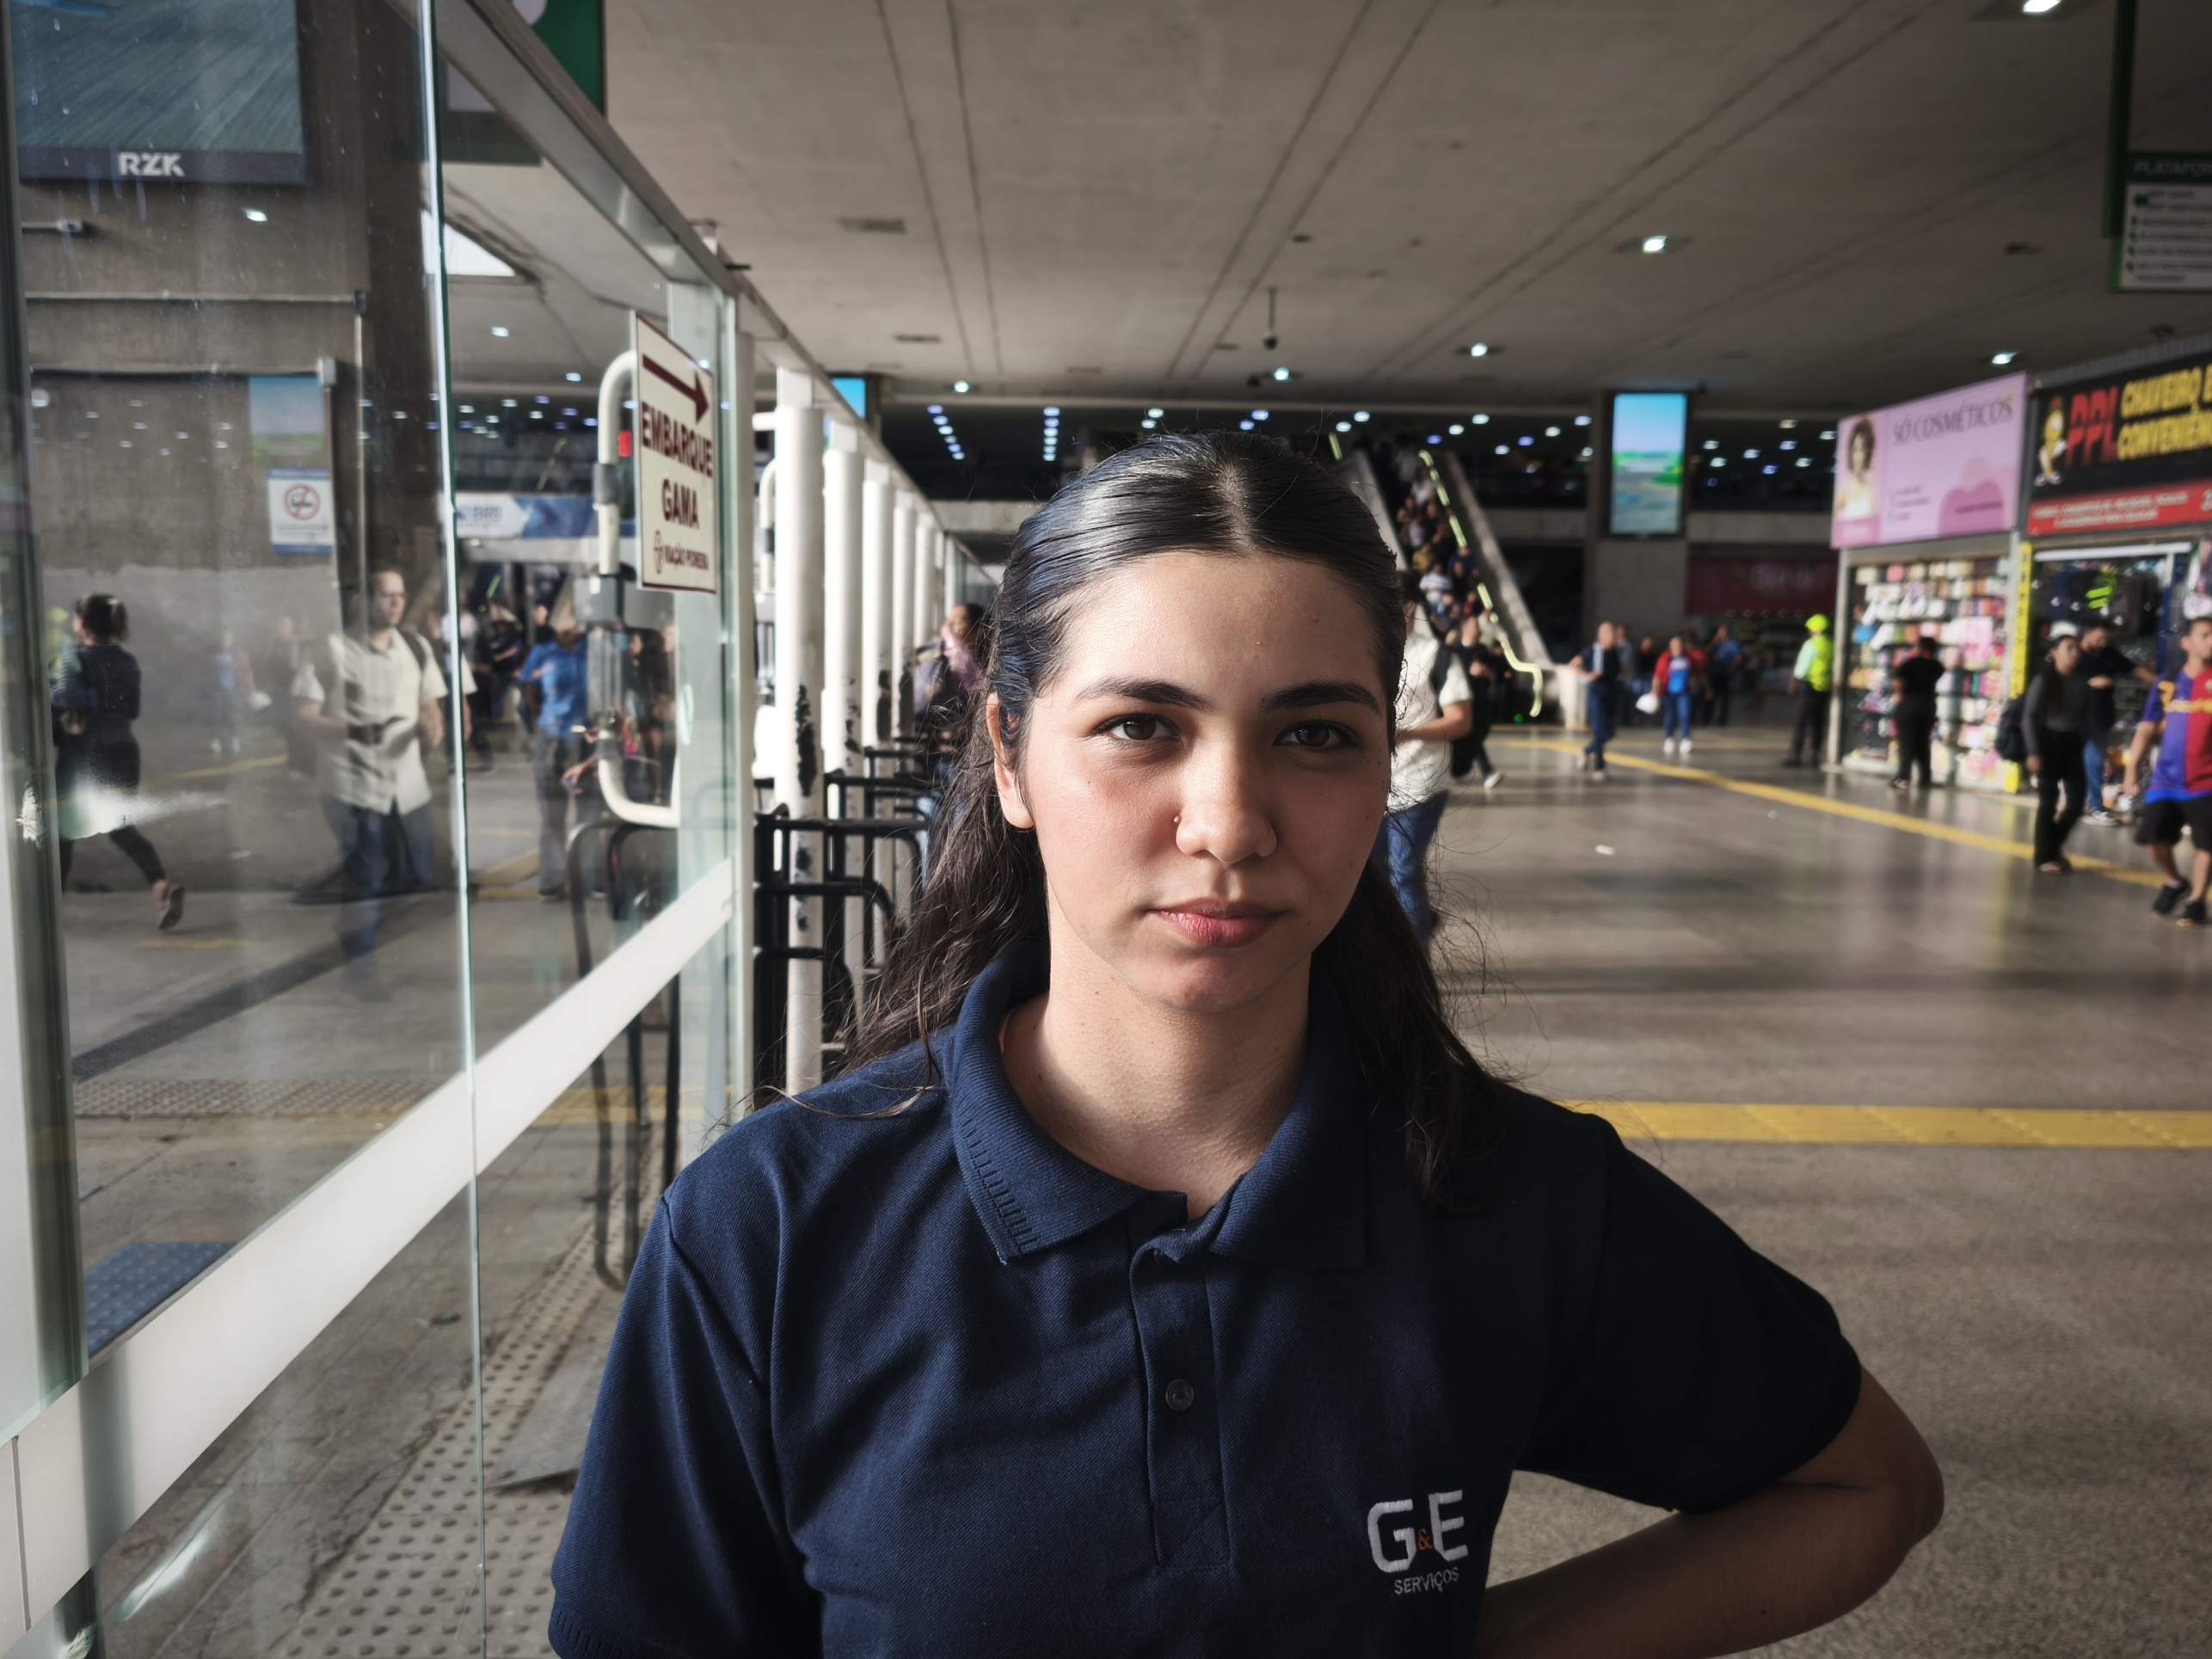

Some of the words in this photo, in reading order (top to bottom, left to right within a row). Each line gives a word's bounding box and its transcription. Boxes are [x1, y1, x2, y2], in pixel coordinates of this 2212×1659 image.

[119, 151, 186, 177] RZK
[1912, 396, 2013, 441] COSMÉTICOS
[2121, 365, 2202, 420] CHAVEIRO
[642, 401, 714, 478] EMBARQUE
[2065, 386, 2118, 468] PPL
[661, 477, 700, 530] GAMA
[1367, 1489, 1469, 1573] G&E
[1393, 1566, 1459, 1595] SERVIÇOS
